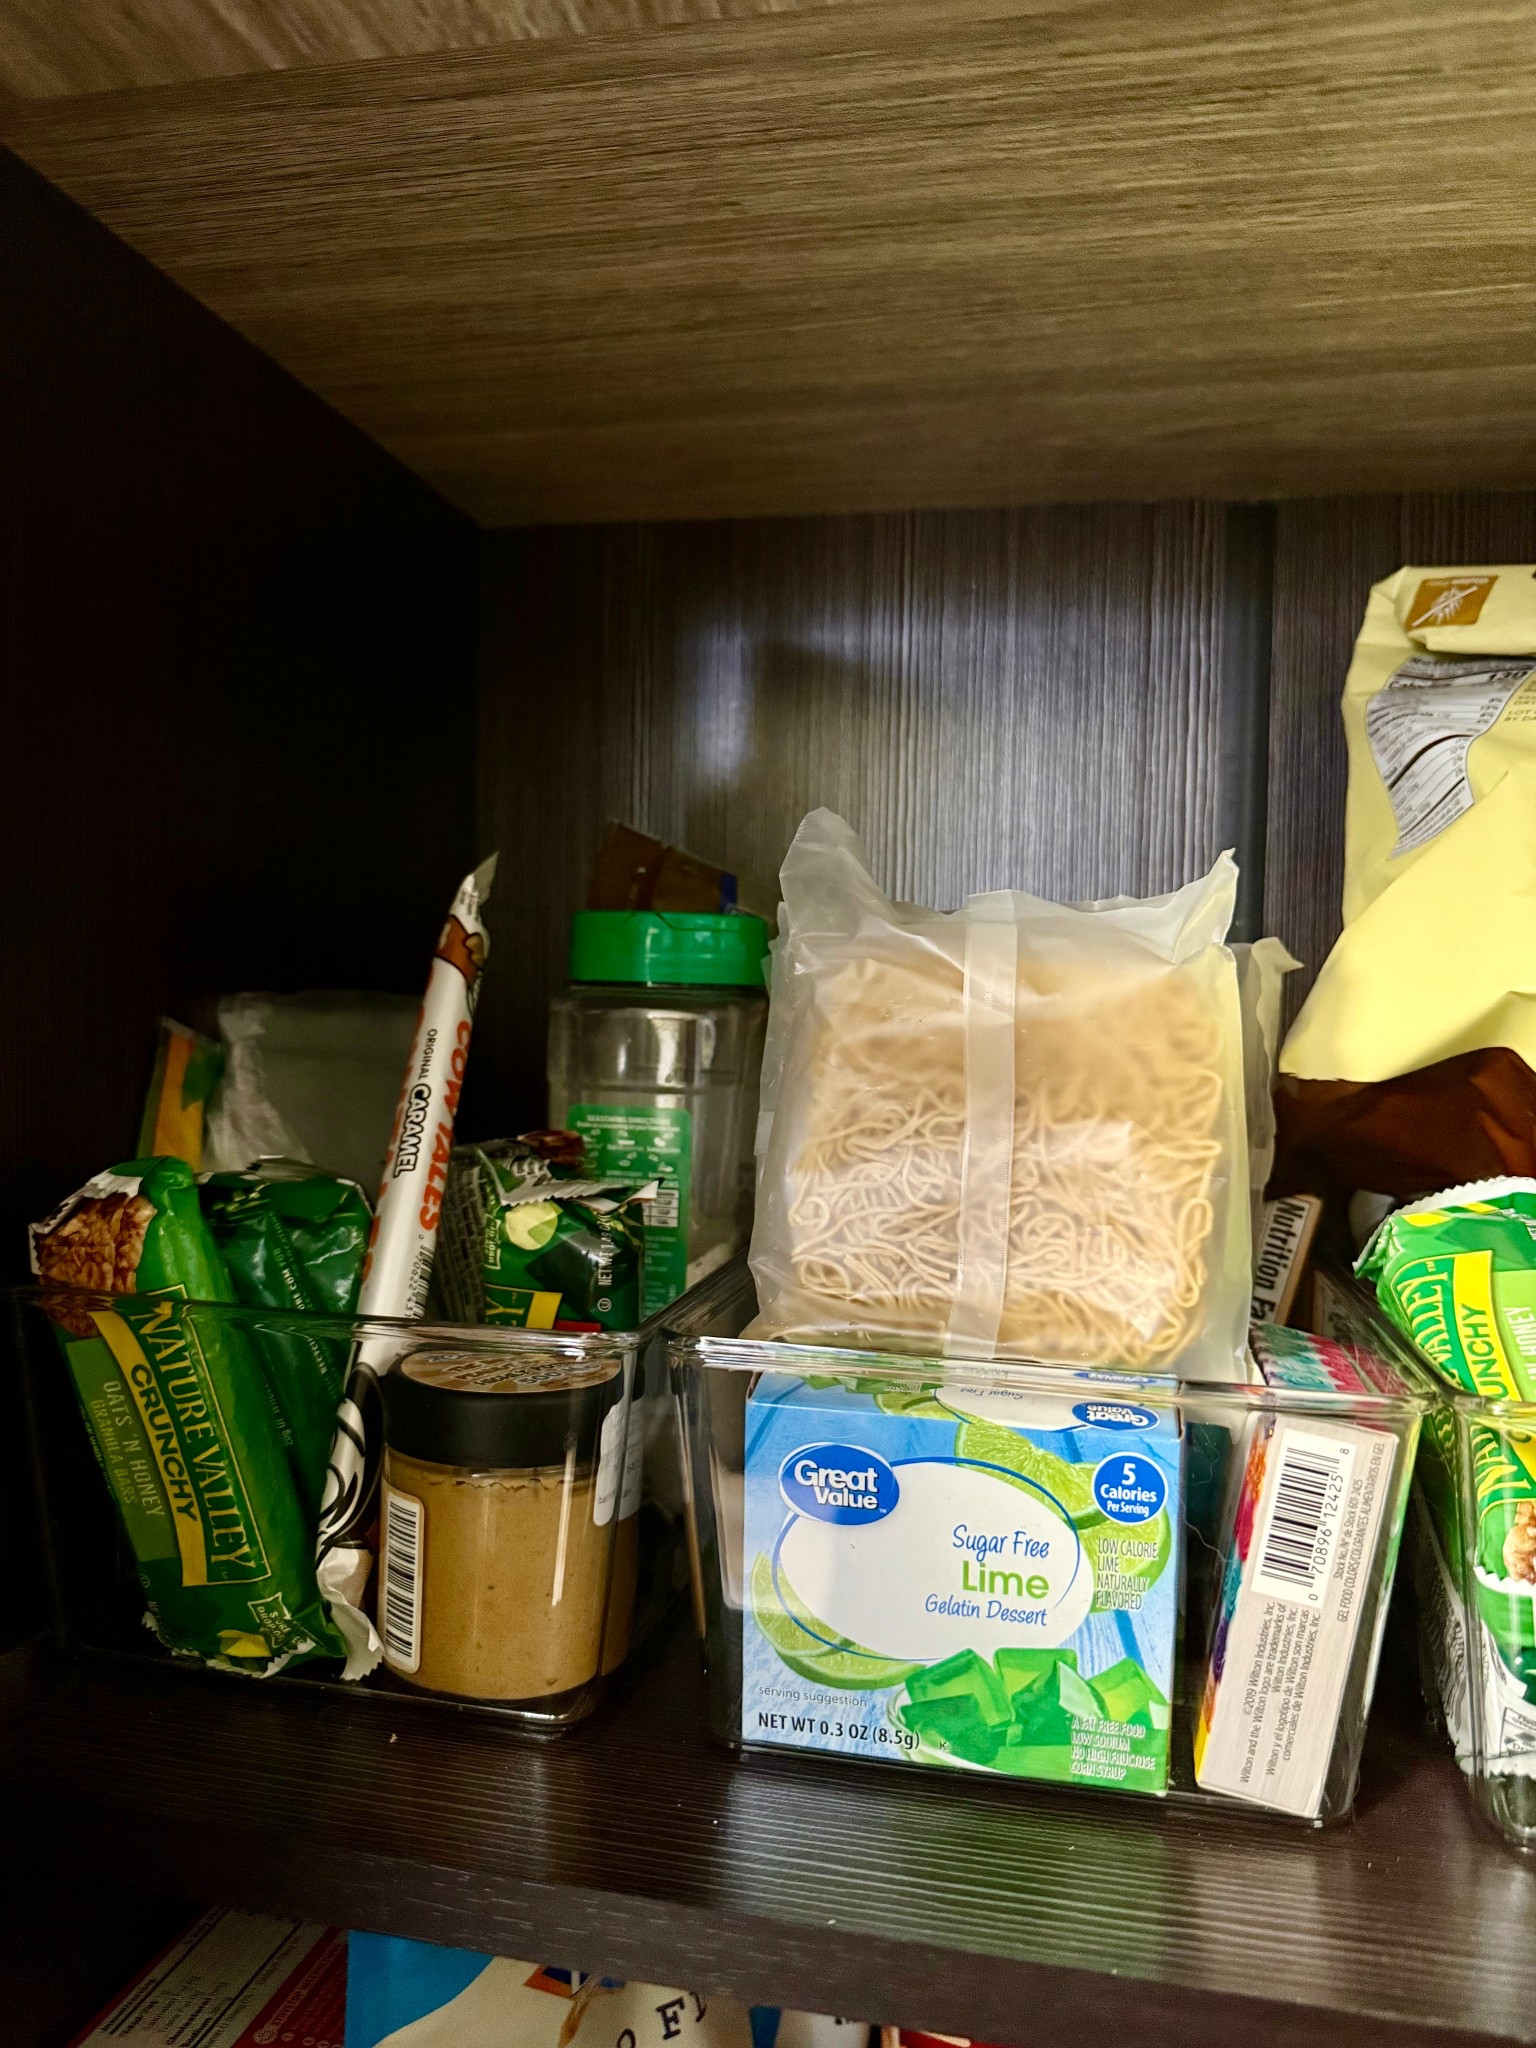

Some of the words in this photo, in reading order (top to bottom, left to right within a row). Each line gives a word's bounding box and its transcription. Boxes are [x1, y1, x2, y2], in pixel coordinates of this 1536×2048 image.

[419, 1028, 438, 1081] ORIGINAL
[444, 1020, 473, 1117] COW
[394, 1083, 431, 1180] CARAMEL
[419, 1121, 453, 1231] TALES
[1254, 1199, 1306, 1290] Nutrition
[598, 1270, 612, 1286] NET
[1461, 1303, 1510, 1400] UNCHY
[1086, 1409, 1149, 1426] Great
[1087, 1404, 1132, 1415] Value
[129, 1302, 215, 1443] NATURE
[193, 1444, 256, 1568] VALLEY
[131, 1363, 198, 1522] CRUNCHY
[103, 1381, 132, 1427] OATS
[129, 1459, 166, 1517] HONEY
[1372, 1441, 1385, 1455] GEL
[1370, 1455, 1382, 1465] EN
[794, 1459, 879, 1493] Great
[1121, 1462, 1136, 1486] 5
[813, 1485, 878, 1511] Value
[1100, 1484, 1157, 1502] Calories
[1359, 1465, 1380, 1515] ALIMENTARIOS
[1106, 1500, 1120, 1512] Per
[1120, 1502, 1150, 1517] Serving
[1344, 1509, 1357, 1528] Stock
[1310, 1527, 1332, 1574] 70896
[1322, 1473, 1343, 1518] 12425
[1342, 1528, 1352, 1537] de
[952, 1524, 1008, 1562] Sugar
[1013, 1530, 1050, 1558] Free
[1098, 1537, 1119, 1555] LOW
[1120, 1540, 1158, 1559] CALORIE
[1344, 1515, 1369, 1588] COLORS/COLORANTES
[1097, 1556, 1119, 1573] LIME
[1333, 1560, 1346, 1579] Stock
[962, 1560, 1050, 1599] Lime
[1096, 1573, 1149, 1593] NATURALLY
[1096, 1591, 1142, 1610] FLAVORED
[1263, 1600, 1275, 1615] Inc.
[1276, 1602, 1286, 1612] of
[1308, 1592, 1318, 1601] 0
[1339, 1587, 1354, 1608] FOOD
[925, 1593, 980, 1618] Gelatin
[986, 1599, 1047, 1626] Dessert
[1286, 1606, 1298, 1621] Inc.
[1309, 1611, 1320, 1627] Inc.
[1336, 1609, 1349, 1622] GEL
[1296, 1608, 1309, 1639] marcas
[1254, 1615, 1273, 1659] Industries,
[1265, 1613, 1284, 1660] trademarks
[1277, 1622, 1296, 1665] Industries,
[1292, 1639, 1302, 1656] son
[1300, 1629, 1318, 1671] Industries,
[1248, 1659, 1262, 1687] Wilton
[1264, 1661, 1274, 1675] are
[1271, 1665, 1285, 1693] Wilton
[1285, 1656, 1299, 1684] Wilton
[758, 1685, 800, 1701] serving
[803, 1691, 867, 1708] suggestion
[1258, 1675, 1273, 1695] logo
[1282, 1685, 1293, 1696] de
[1294, 1671, 1308, 1699] Wilton
[1252, 1695, 1266, 1723] Wilton
[1275, 1697, 1292, 1732] logotipo
[1291, 1700, 1302, 1711] de
[758, 1711, 787, 1730] NET
[792, 1716, 816, 1733] WT
[820, 1721, 843, 1737] 0.3
[849, 1724, 868, 1741] OZ
[872, 1726, 920, 1749] (8.5g)
[1081, 1717, 1097, 1731] FAT
[1098, 1719, 1120, 1735] FREE
[1120, 1723, 1146, 1739] FOOD
[1249, 1724, 1260, 1738] the
[1273, 1732, 1283, 1740] el
[1281, 1712, 1299, 1760] comerciales
[1071, 1731, 1092, 1746] LOW
[1093, 1734, 1131, 1752] SODIUM
[1245, 1738, 1257, 1755] and
[1273, 1741, 1283, 1749] y
[1072, 1745, 1086, 1760] NO
[1087, 1747, 1110, 1765] HIGH
[1110, 1751, 1156, 1771] FRUCTOSE
[1239, 1755, 1254, 1783] Wilton
[1265, 1747, 1279, 1775] Wilton
[1070, 1761, 1095, 1777] CORN
[1096, 1764, 1126, 1781] SYRUP
